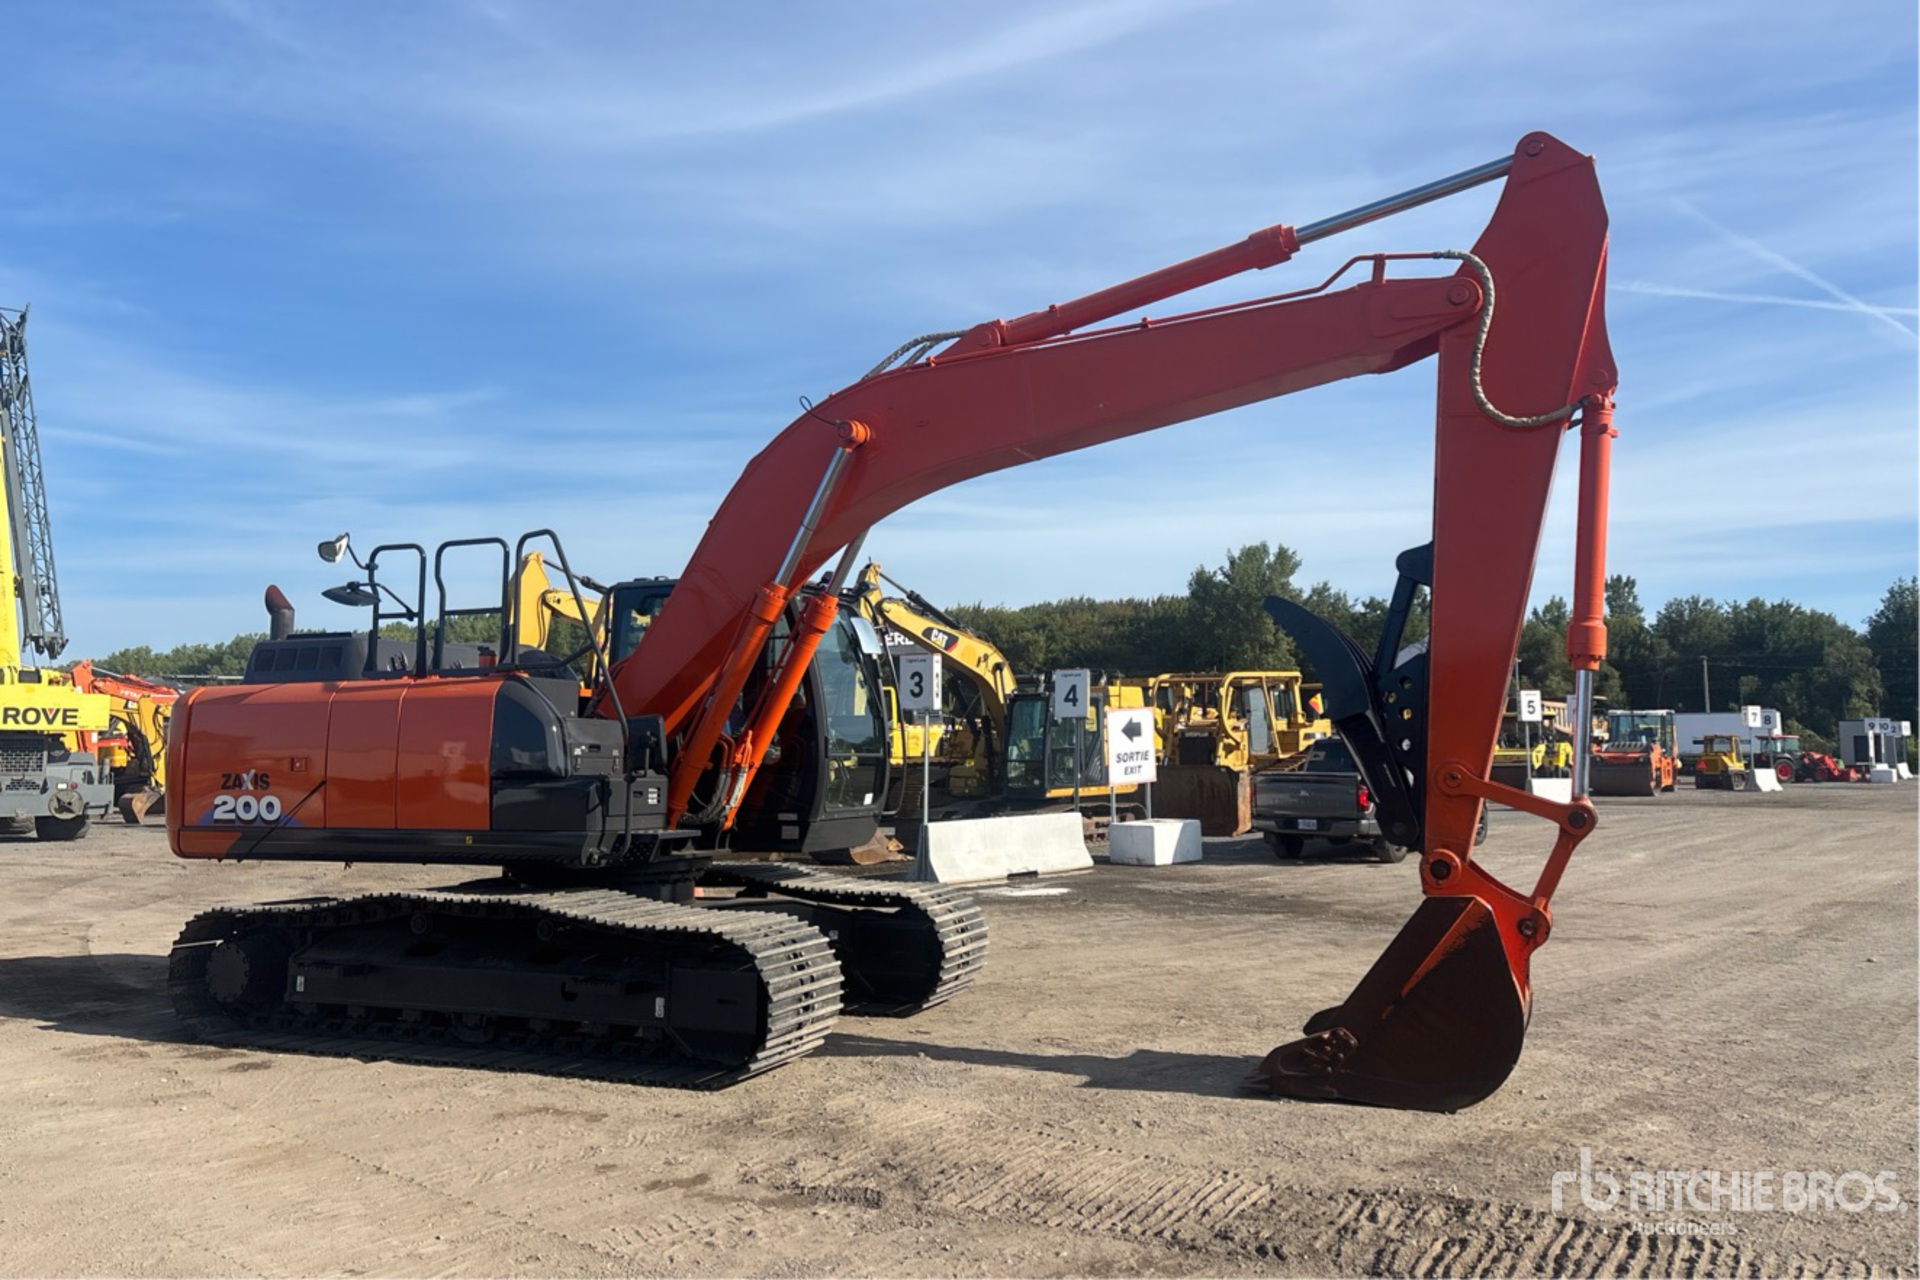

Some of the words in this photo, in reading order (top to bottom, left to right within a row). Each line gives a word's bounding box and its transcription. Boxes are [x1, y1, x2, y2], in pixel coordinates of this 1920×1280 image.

[931, 628, 948, 649] CAT
[909, 671, 924, 698] 3
[1063, 684, 1079, 708] 4
[1527, 700, 1536, 715] 5
[2, 707, 78, 726] ROVE
[1751, 712, 1758, 722] 7
[1763, 715, 1772, 725] 8
[1868, 722, 1876, 730] 9
[1116, 750, 1150, 763] SORTIE
[1124, 765, 1142, 776] EXIT
[221, 769, 270, 790] ZAXIS
[213, 794, 282, 825] 200
